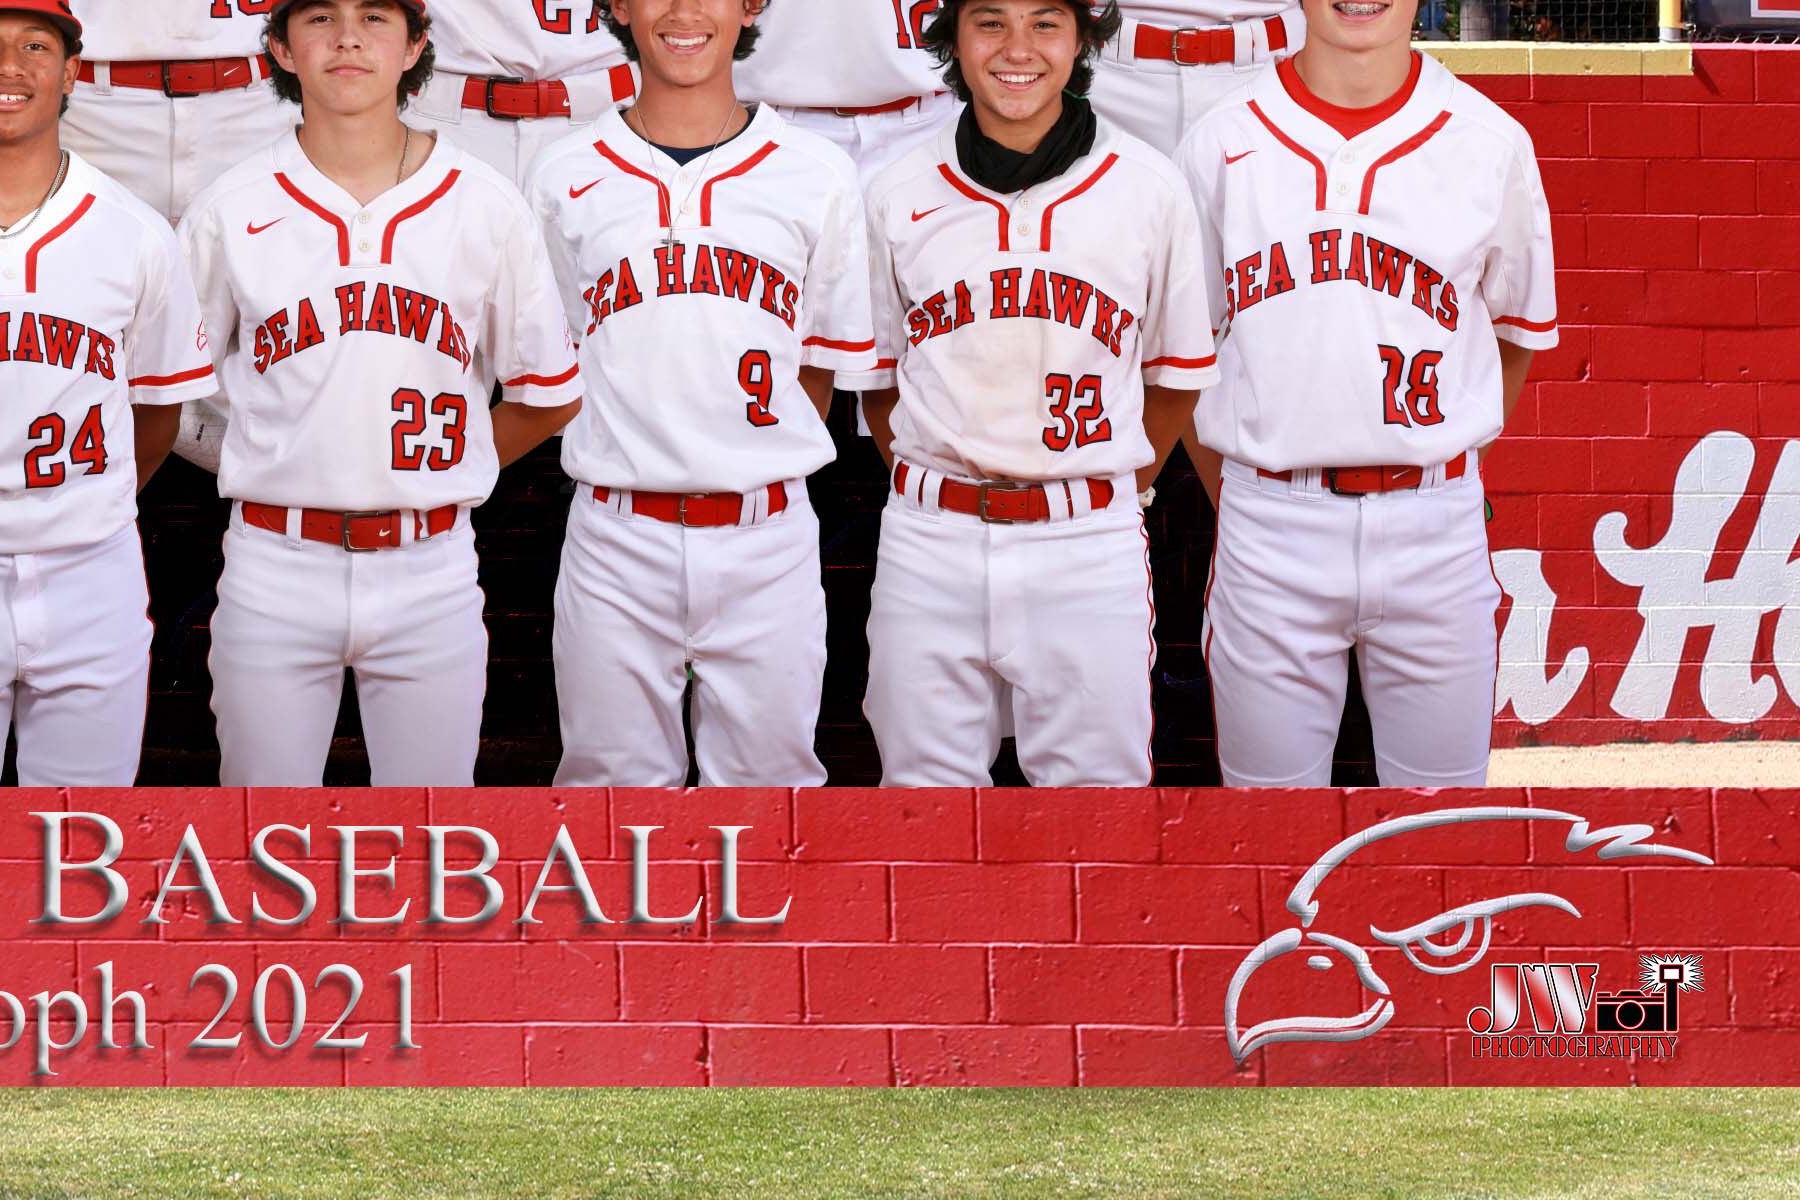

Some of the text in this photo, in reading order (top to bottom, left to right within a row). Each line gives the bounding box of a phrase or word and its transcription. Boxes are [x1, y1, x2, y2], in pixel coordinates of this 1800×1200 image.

[655, 243, 798, 331] HAWKS
[907, 267, 1134, 357] SEA HAWKS
[1310, 228, 1458, 331] HAWKS
[254, 297, 325, 374] SEA
[391, 387, 468, 473] 23
[738, 349, 779, 428] 9
[1042, 372, 1113, 452] 32
[24, 404, 109, 490] 24
